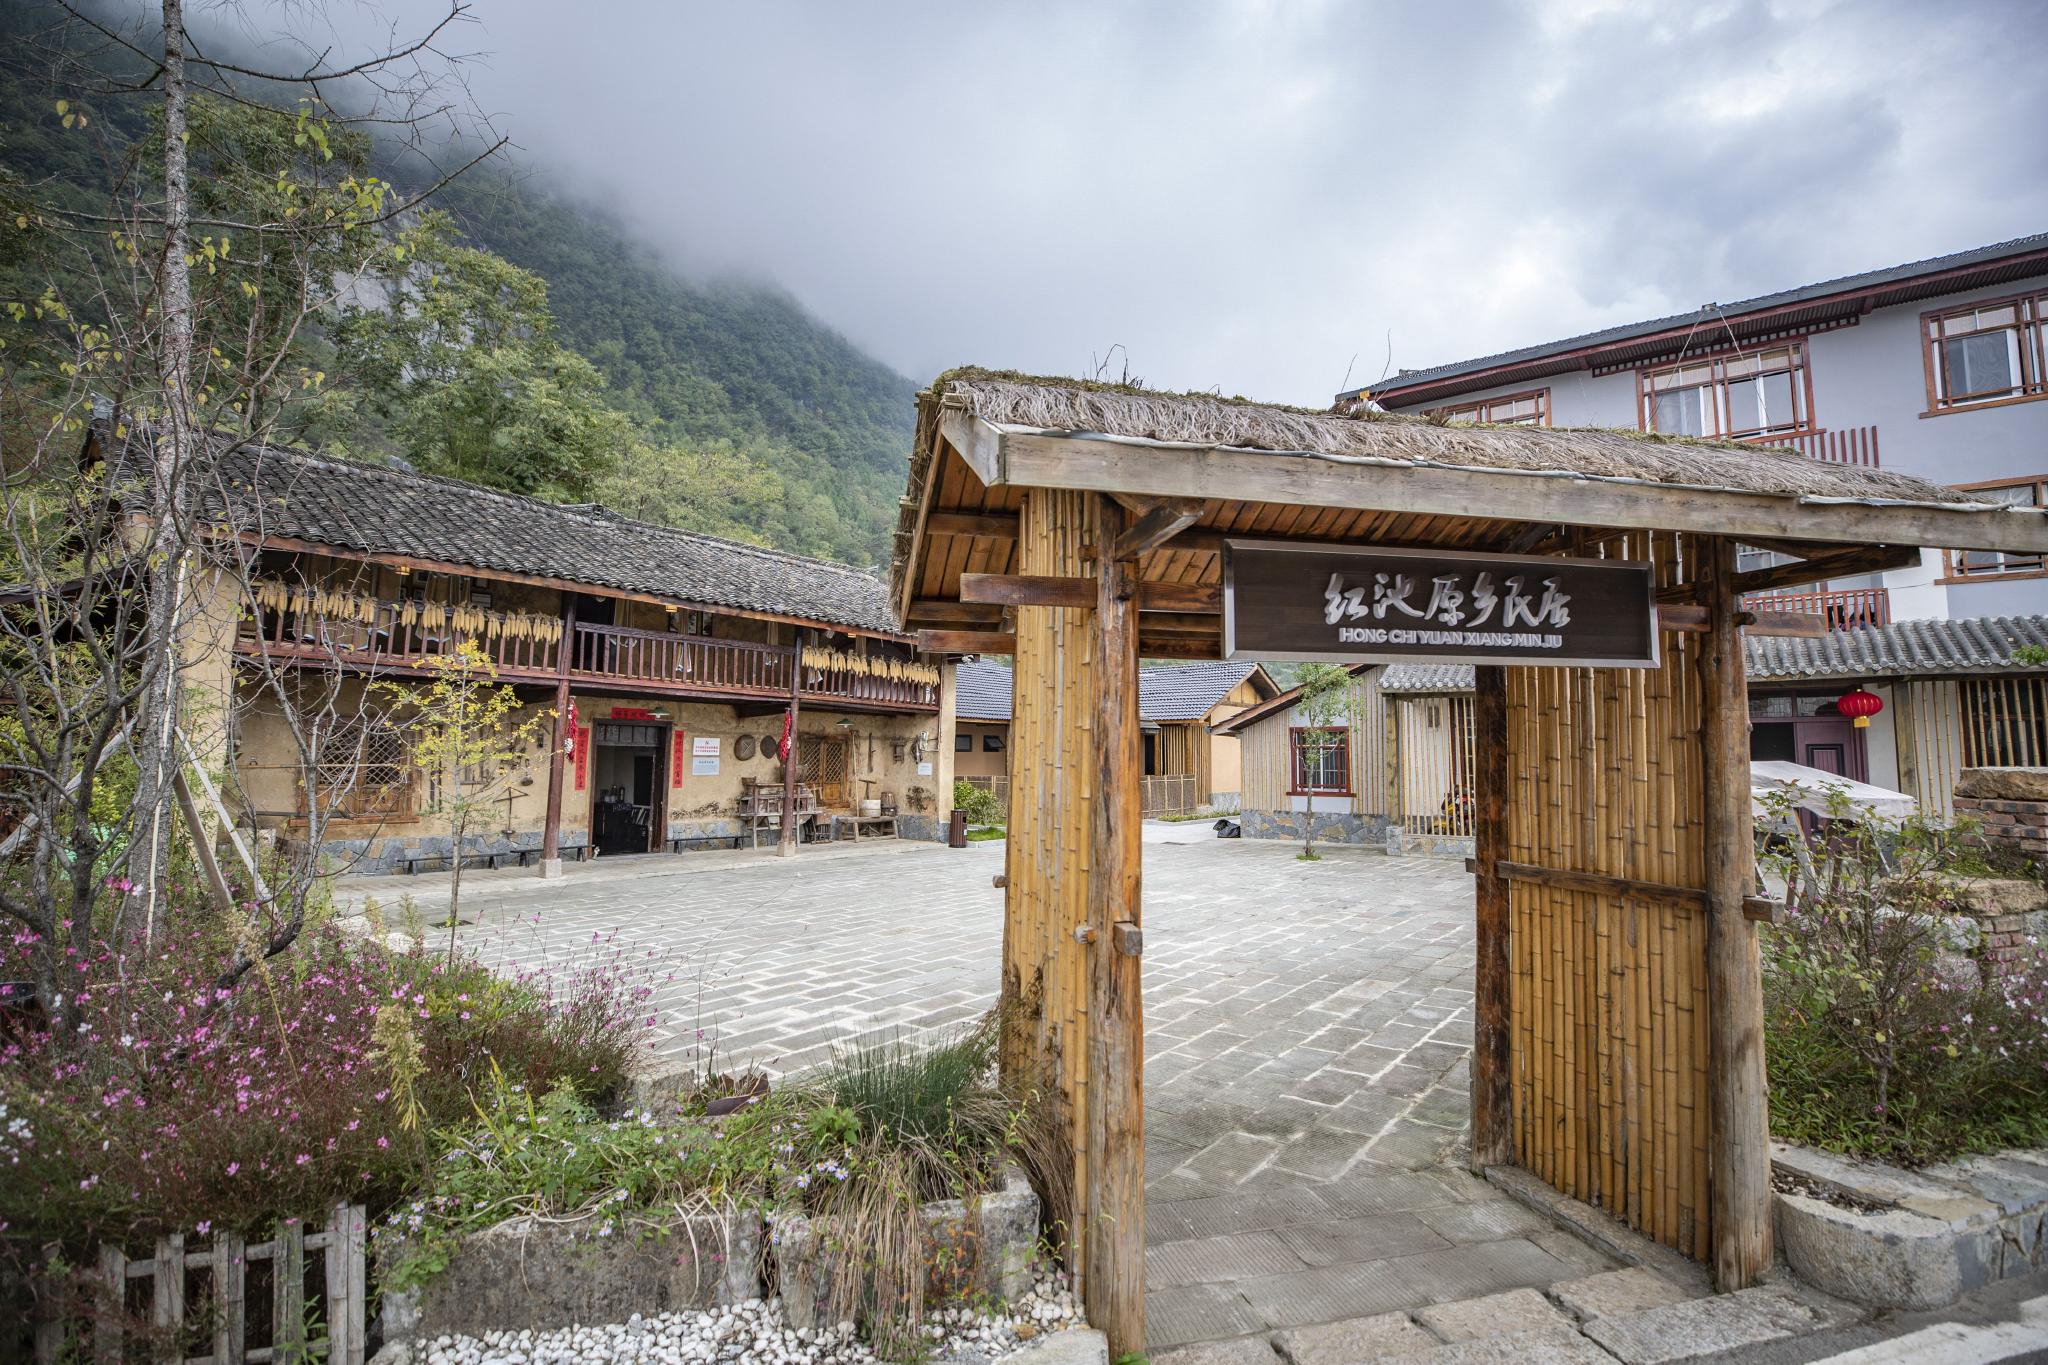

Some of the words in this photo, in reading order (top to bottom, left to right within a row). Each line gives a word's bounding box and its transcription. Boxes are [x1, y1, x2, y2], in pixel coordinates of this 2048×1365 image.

[1324, 572, 1571, 628] 红池原乡民居
[1340, 628, 1387, 643] HONG
[1389, 629, 1417, 644] CHI
[1419, 631, 1463, 645] YUAN
[1464, 632, 1512, 647] XIANG
[1512, 633, 1541, 647] MIN
[1543, 634, 1562, 648] JU
